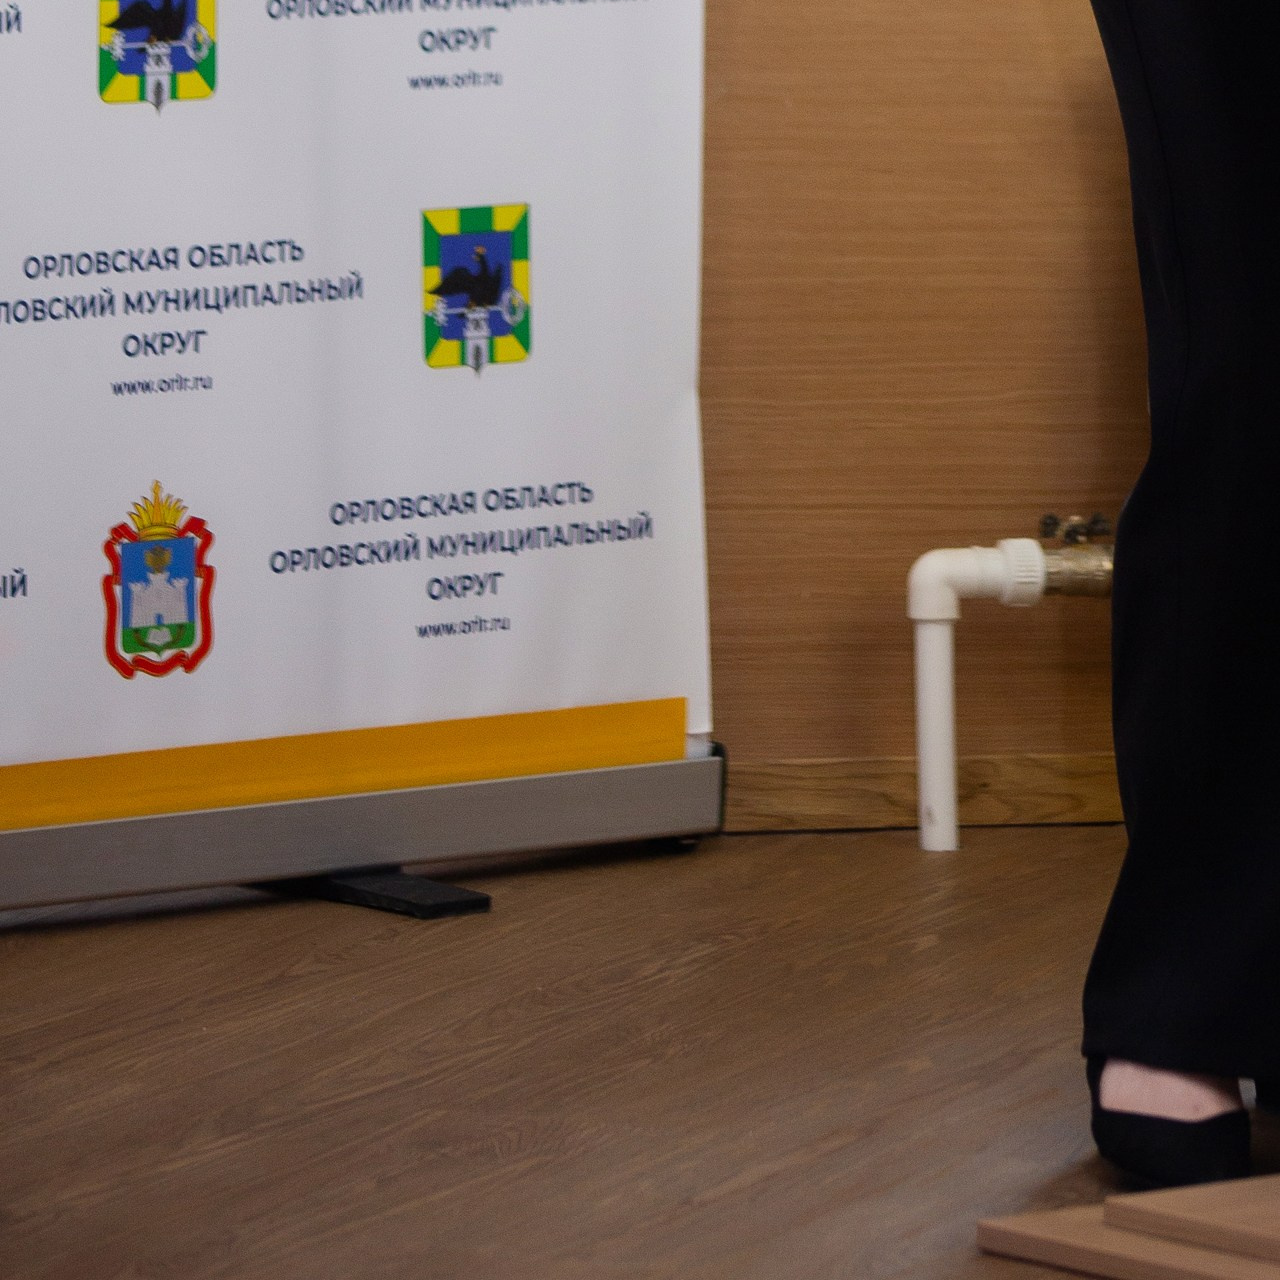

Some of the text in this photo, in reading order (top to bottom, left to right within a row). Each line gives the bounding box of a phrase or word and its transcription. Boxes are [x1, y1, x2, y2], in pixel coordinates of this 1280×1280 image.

[418, 26, 498, 54] ОКРУГ
[22, 239, 305, 280] ОРЛОВСКАЯ ОБЛАСТЬ
[123, 270, 364, 316] МУНИЦИПАЛЬНЫЙ
[121, 329, 208, 358] ОКРУГ
[329, 481, 594, 526] ОРЛОВСКАЯ ОБЛАСТЬ
[268, 510, 654, 574] ОРЛОВСКИЙ МУНИЦИПАЛЬНЫЙ
[426, 571, 505, 601] ОКРУГ
